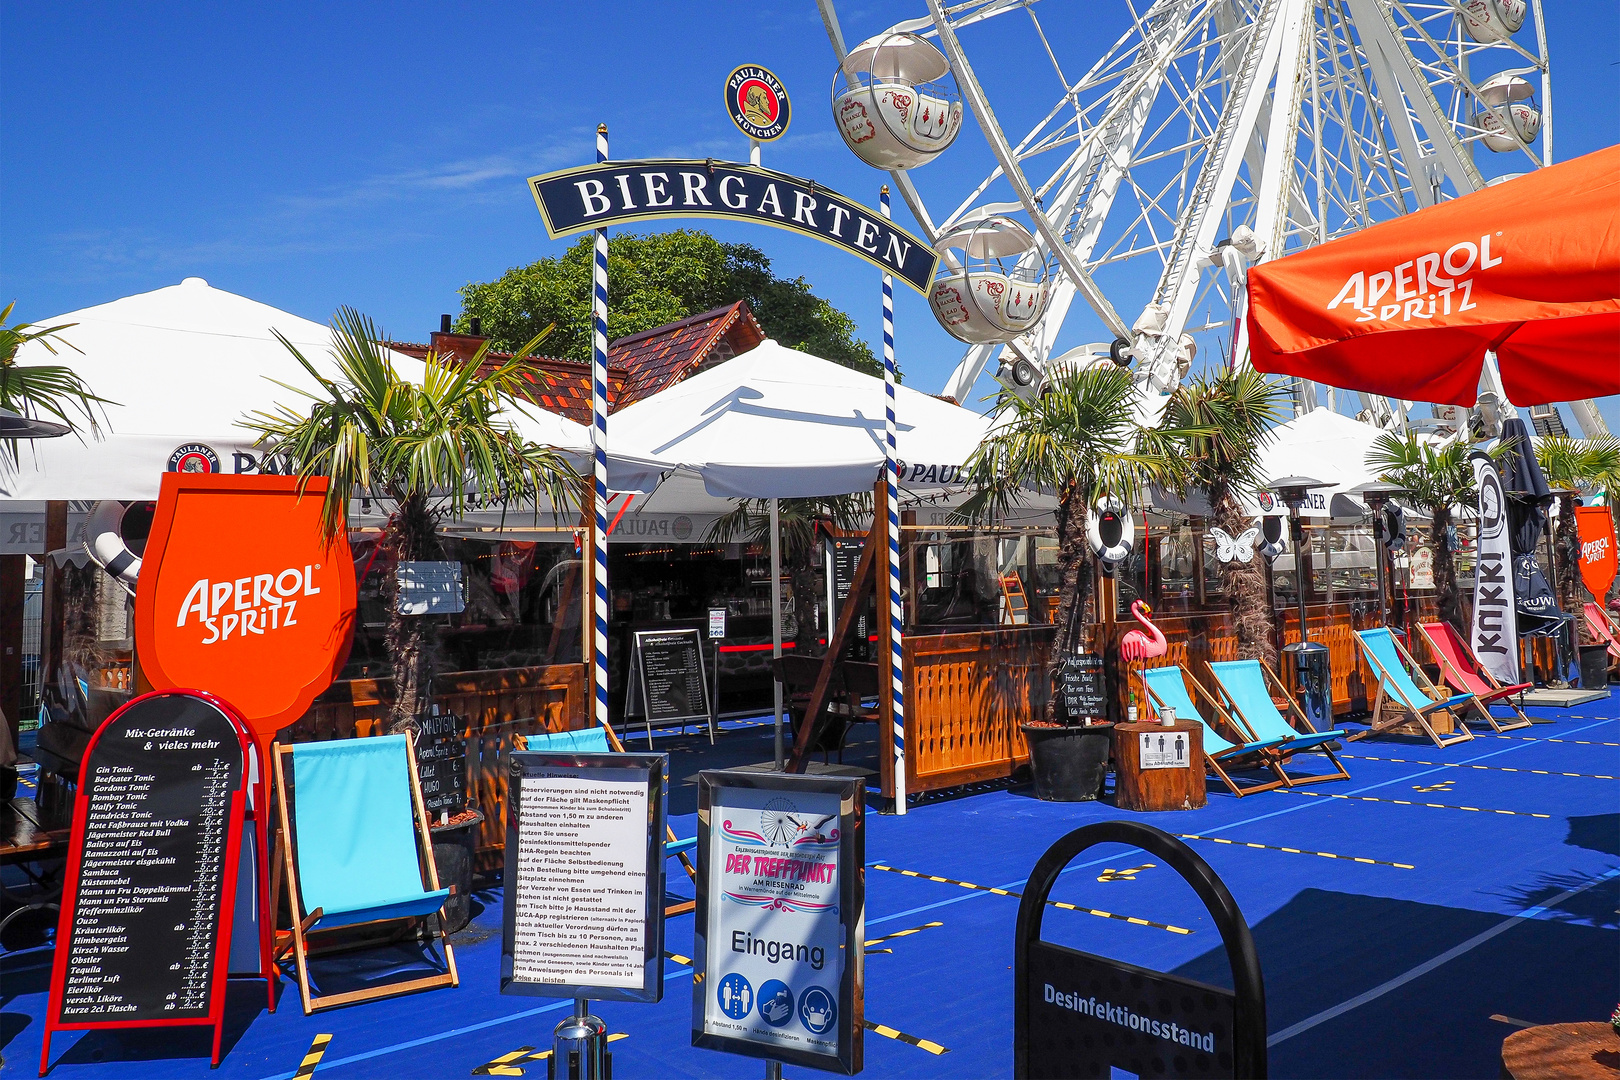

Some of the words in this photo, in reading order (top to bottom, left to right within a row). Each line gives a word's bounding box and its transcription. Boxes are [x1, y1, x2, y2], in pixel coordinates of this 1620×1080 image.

[729, 68, 785, 102] PAULANER
[735, 112, 783, 137] MÜNCHEN
[574, 172, 912, 270] BIERGARTEN
[1327, 234, 1502, 310] APEROL
[171, 446, 216, 463] PAULANER
[1581, 536, 1609, 559] APEROL
[176, 565, 320, 627] APEROL
[124, 727, 195, 738] Mix-Getränke
[144, 741, 152, 750] &
[159, 741, 188, 750] vieles
[191, 740, 220, 749] mehr
[424, 780, 439, 793] HUGO
[91, 803, 113, 811] Malfy
[87, 831, 137, 840] Jägermeister
[116, 840, 130, 848] auf
[132, 849, 146, 857] auf
[84, 859, 134, 868] Jägermeister
[136, 858, 176, 866] eisgekühlt
[568, 859, 624, 867] Selbstbedienung
[726, 854, 751, 874] DER
[754, 857, 836, 884] TREFFPUNKT
[81, 877, 130, 886] Küstennebel
[766, 880, 804, 890] RIESENRAD
[133, 885, 191, 894] Doppelkümmel
[77, 907, 144, 915] Pfefferminzlikör
[75, 926, 126, 934] Kräuterlikör
[74, 936, 127, 944] Himbeergeist
[732, 930, 824, 970] Eingang
[67, 986, 103, 994] Eierlikör
[1044, 983, 1214, 1053] Desinfektionsstand
[753, 1028, 768, 1036] Hände
[769, 1031, 800, 1041] desinfizieren
